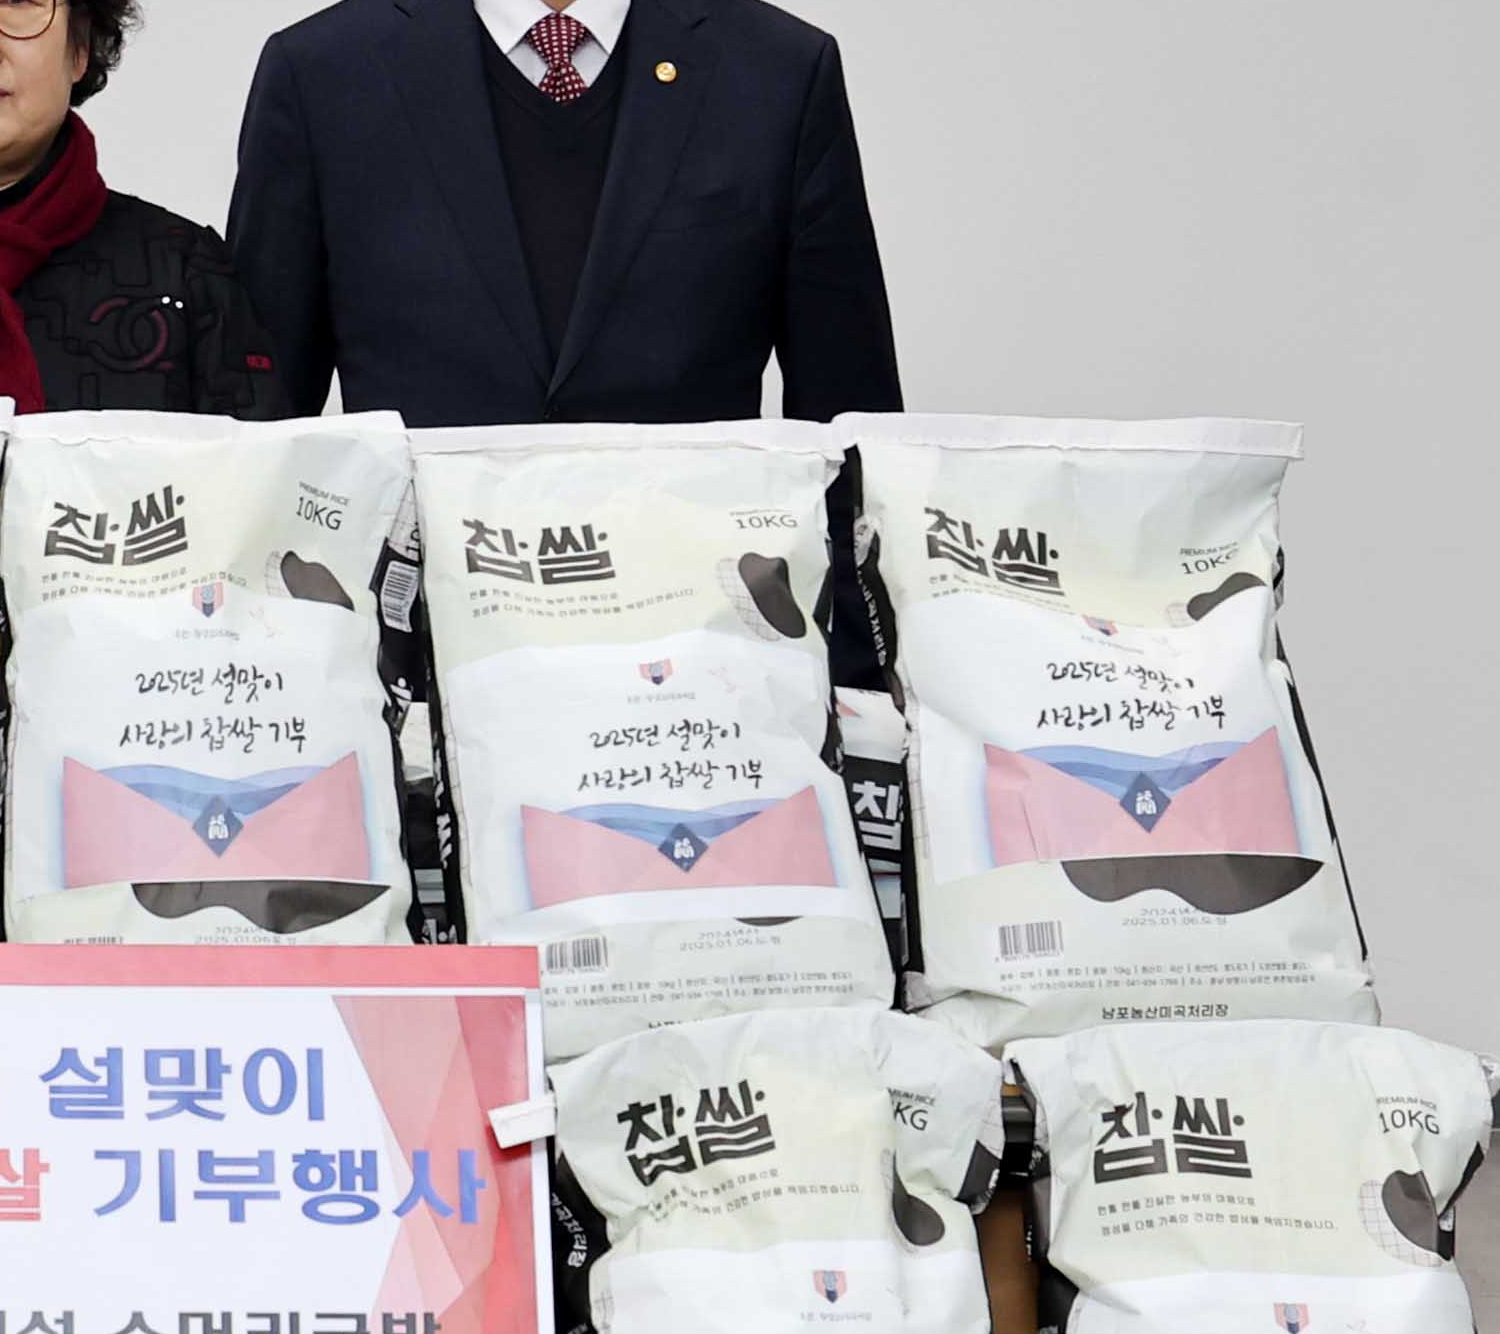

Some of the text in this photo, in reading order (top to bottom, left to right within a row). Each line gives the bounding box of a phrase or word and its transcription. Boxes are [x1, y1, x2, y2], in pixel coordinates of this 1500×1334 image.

[43, 484, 189, 567] 찹쌀
[295, 496, 343, 531] 10KG
[735, 514, 798, 530] 10KG
[462, 519, 616, 586] 찹쌀
[924, 507, 1065, 596] 찹쌀
[135, 662, 283, 704] 2025년 설맞이
[1047, 661, 1195, 693] 2025년 설맞이
[1037, 695, 1226, 732] 사랑의 찹쌀 기부
[119, 715, 306, 754] 사랑의 찹쌀 기부
[589, 718, 741, 752] 2025년 설맞이
[578, 759, 763, 791] 사랑의 찹쌀 기부
[1101, 1003, 1229, 1020] 남포농산미곡처리장
[38, 1046, 325, 1122] 설맞이
[616, 1079, 776, 1188] 찹쌀
[1092, 1091, 1253, 1185] 찹쌀
[1379, 1109, 1441, 1136] 10KG
[93, 1146, 487, 1225] 기부행사
